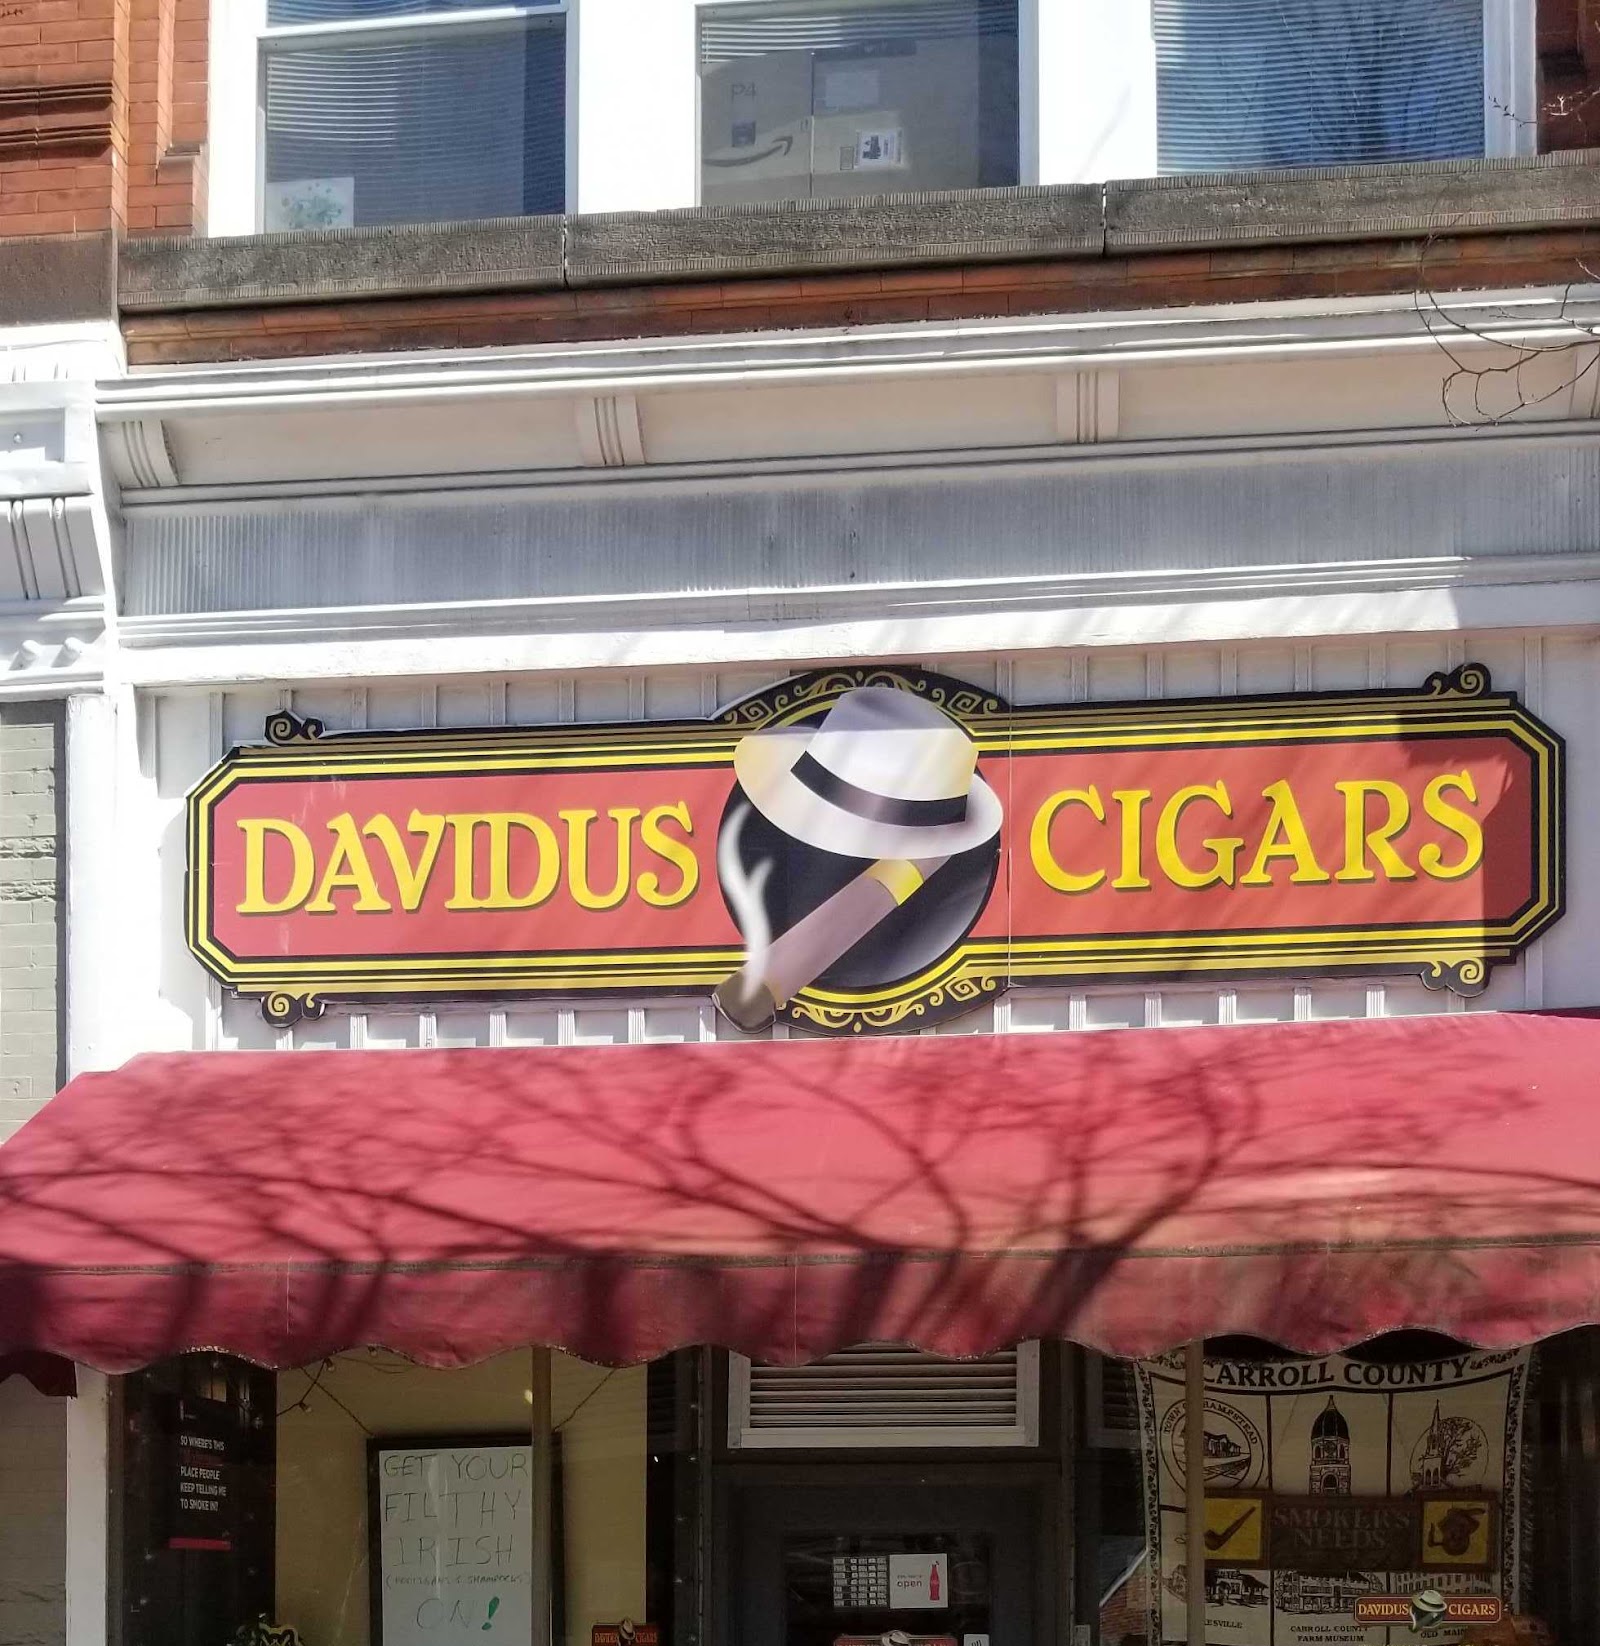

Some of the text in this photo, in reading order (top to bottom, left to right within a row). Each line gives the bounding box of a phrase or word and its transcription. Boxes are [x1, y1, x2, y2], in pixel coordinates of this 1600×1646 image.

[235, 769, 1484, 914] DAVIDUS CIGARS
[1344, 1357, 1470, 1386] COUNTY
[180, 1434, 188, 1446] SO
[213, 1439, 225, 1450] THIS
[180, 1466, 220, 1480] PLACE PEOPLE
[384, 1453, 528, 1480] GET YOUR
[180, 1482, 195, 1493] KEEP
[196, 1483, 217, 1495] TELLING
[180, 1498, 189, 1509] TO
[190, 1500, 209, 1511] SMOKE
[385, 1489, 521, 1528] FILTHY
[391, 1535, 513, 1567] IRISH
[897, 1580, 922, 1589] open
[1358, 1604, 1496, 1615] DAVIDUS CIGARS
